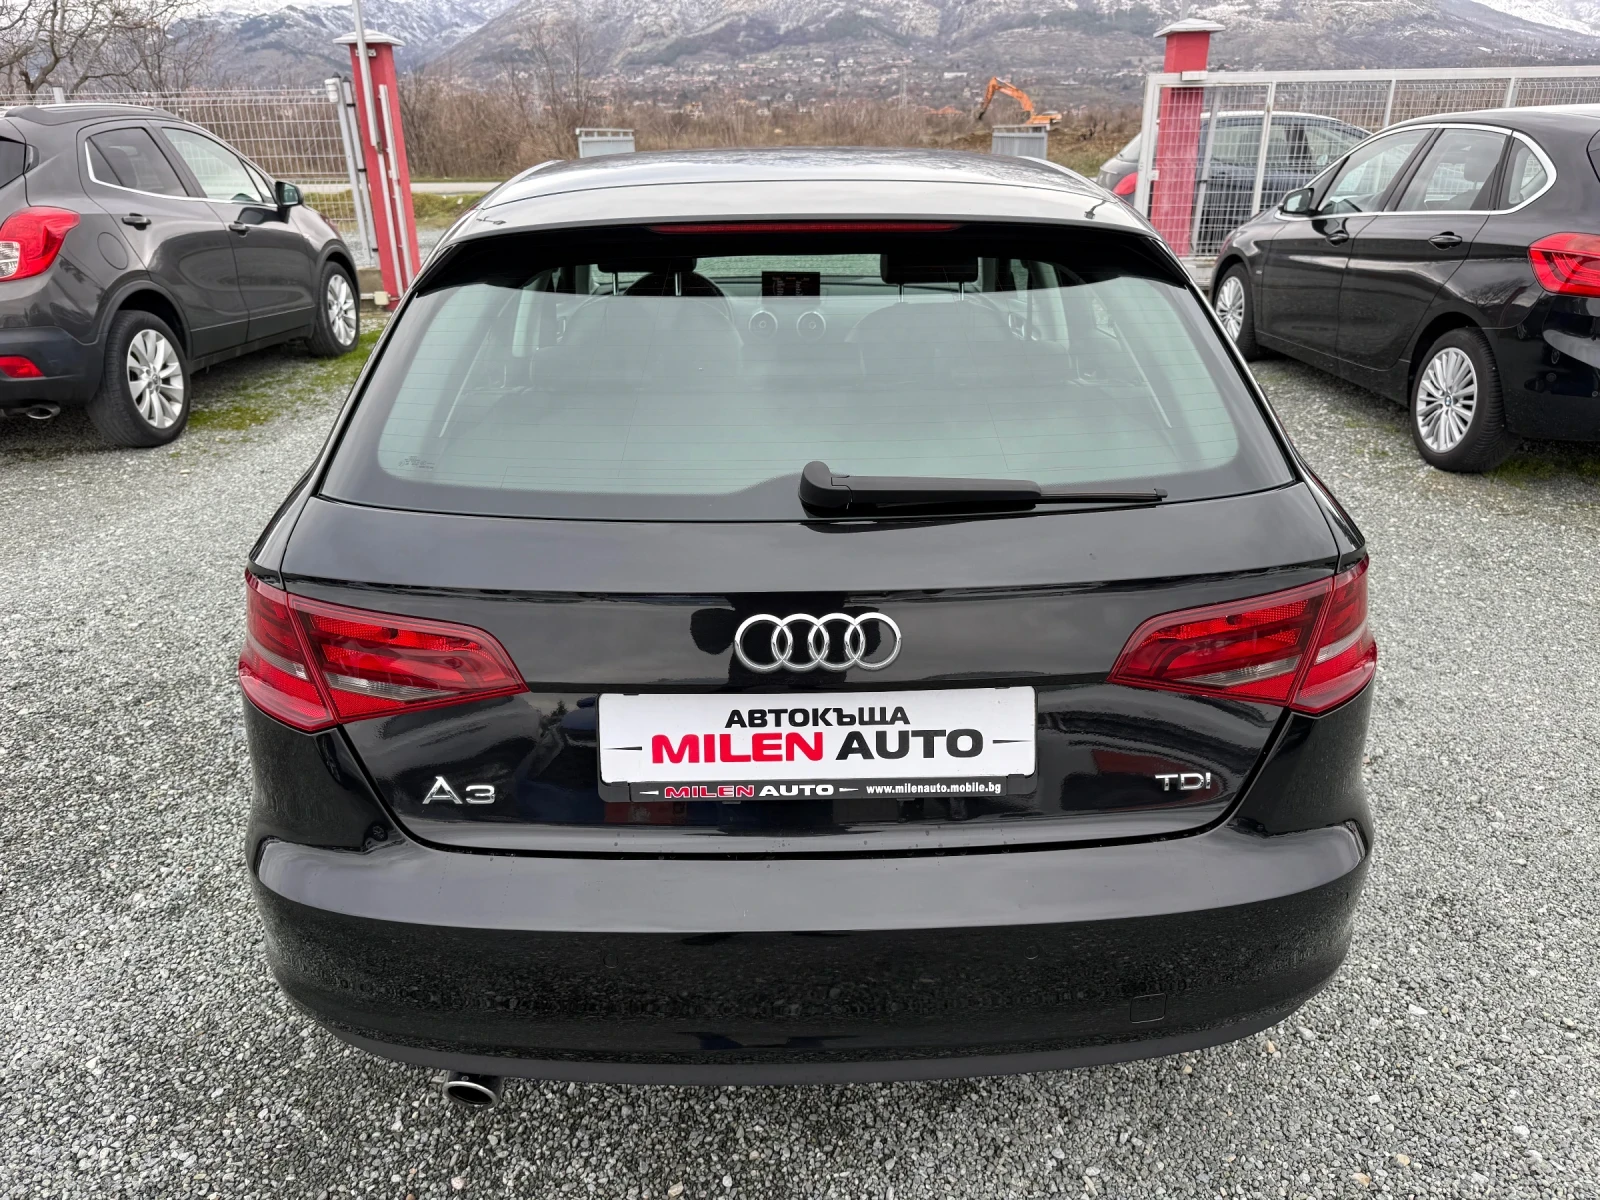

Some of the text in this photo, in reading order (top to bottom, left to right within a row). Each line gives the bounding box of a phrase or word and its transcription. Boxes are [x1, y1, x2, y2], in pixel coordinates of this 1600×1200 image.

[651, 728, 984, 764] MILEN AUTO
[422, 775, 496, 805] A3
[664, 781, 1002, 799] MILEN AUTO www.milenauto.mobile.bg
[1154, 771, 1212, 792] TDI
